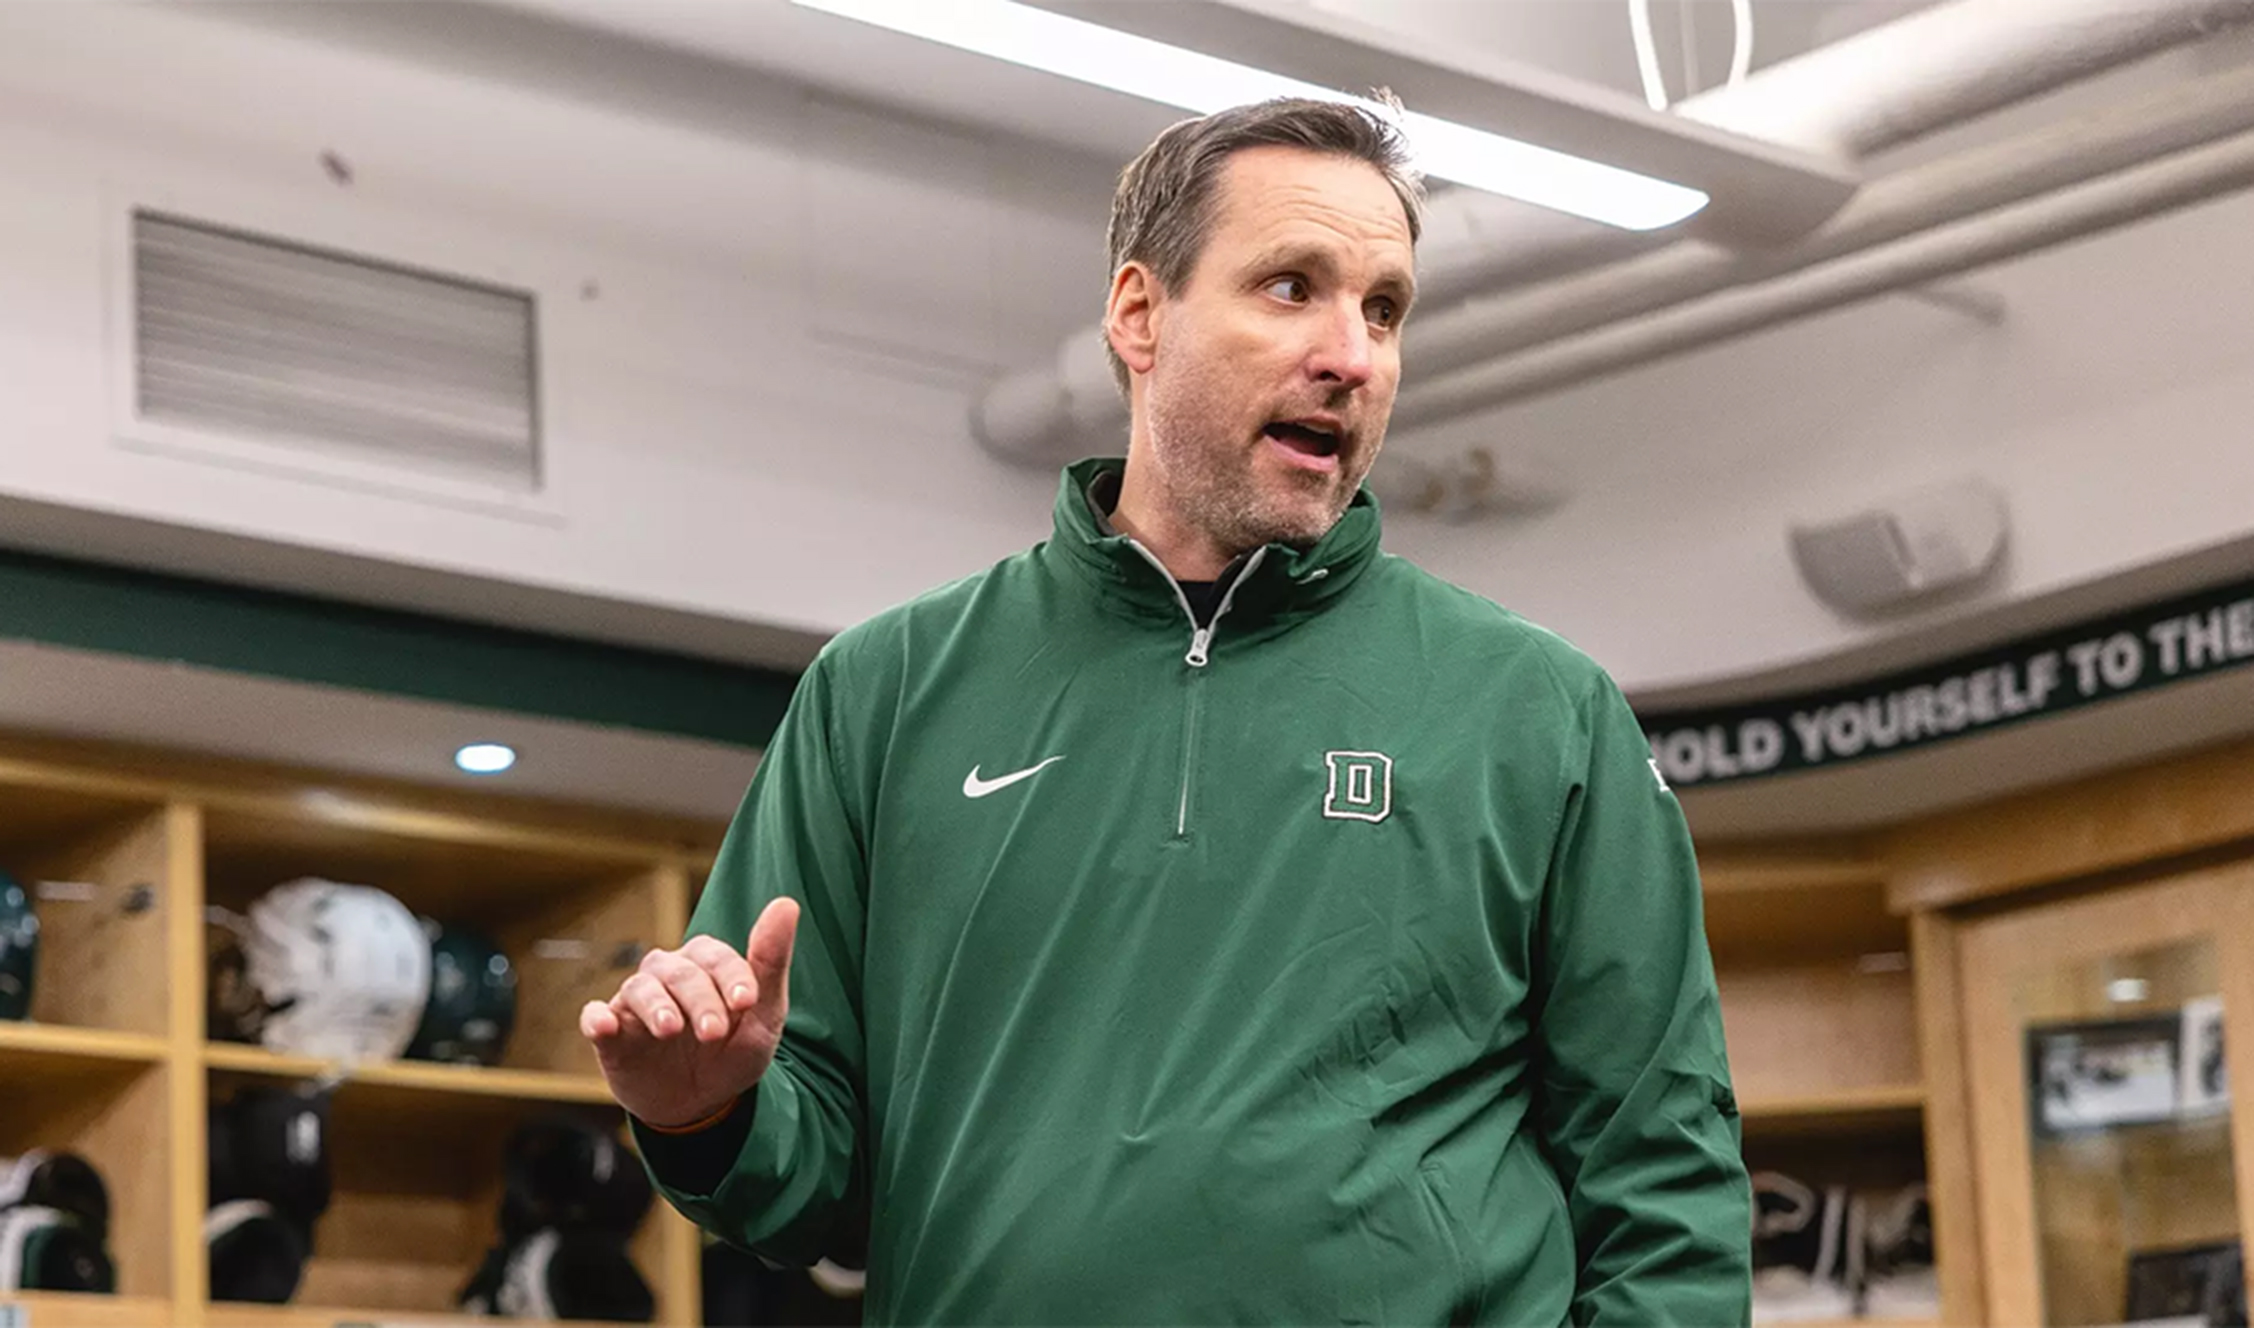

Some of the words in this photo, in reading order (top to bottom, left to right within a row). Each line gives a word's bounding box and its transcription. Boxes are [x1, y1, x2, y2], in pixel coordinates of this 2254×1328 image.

[1791, 652, 2061, 761] YOURSELF
[2068, 632, 2142, 696] TO
[2149, 599, 2254, 673] THE
[1324, 750, 1393, 822] D
